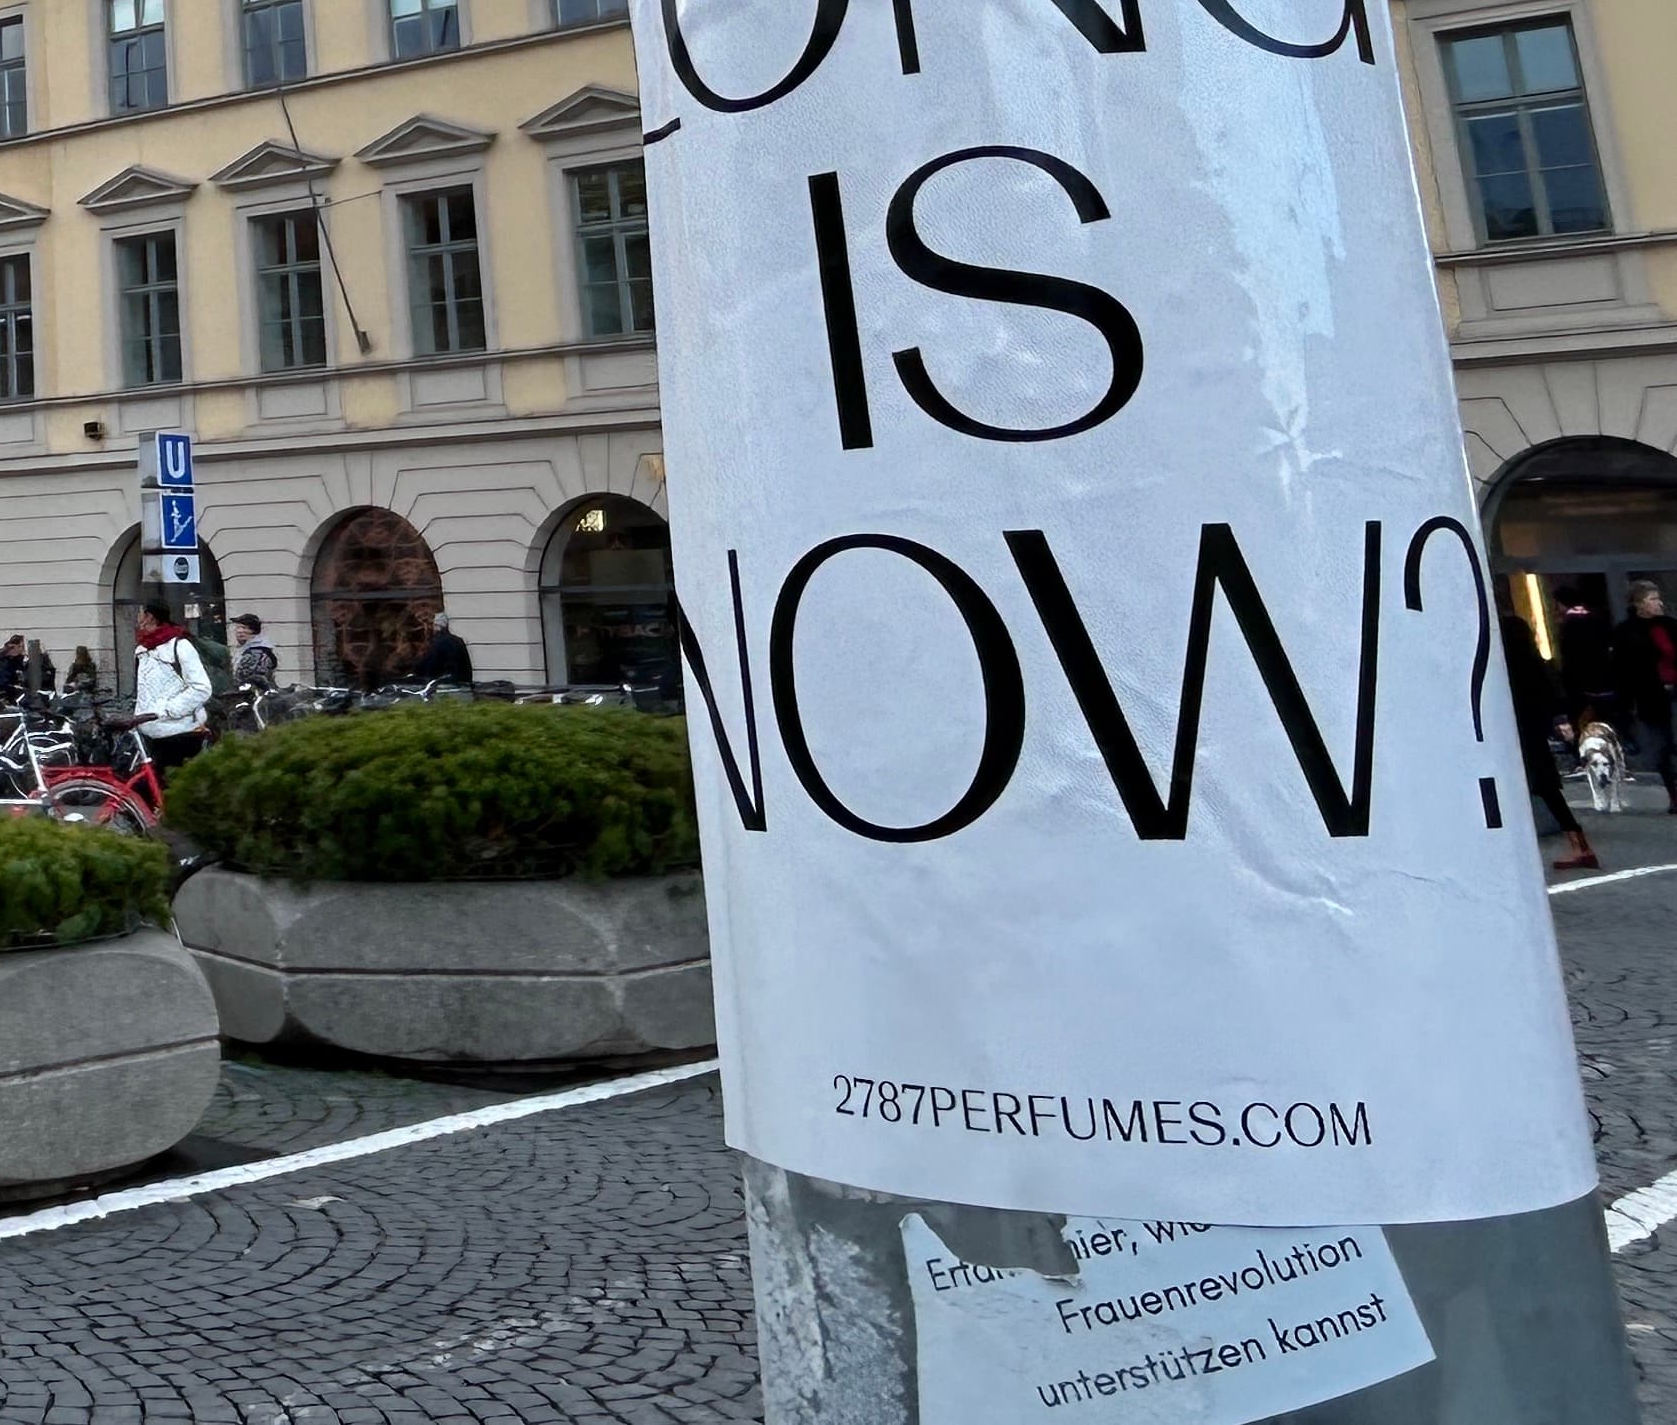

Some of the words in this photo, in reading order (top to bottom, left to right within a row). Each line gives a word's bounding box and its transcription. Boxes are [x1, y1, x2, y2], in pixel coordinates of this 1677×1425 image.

[807, 144, 1145, 451] IS
[165, 440, 186, 479] U
[673, 515, 1503, 844] NOW?
[832, 1074, 1373, 1147] 2787PERFUMES.COM
[1055, 1234, 1363, 1335] Frauenrevolution
[1036, 1335, 1267, 1408] unterstützen
[1267, 1291, 1388, 1354] kannst
